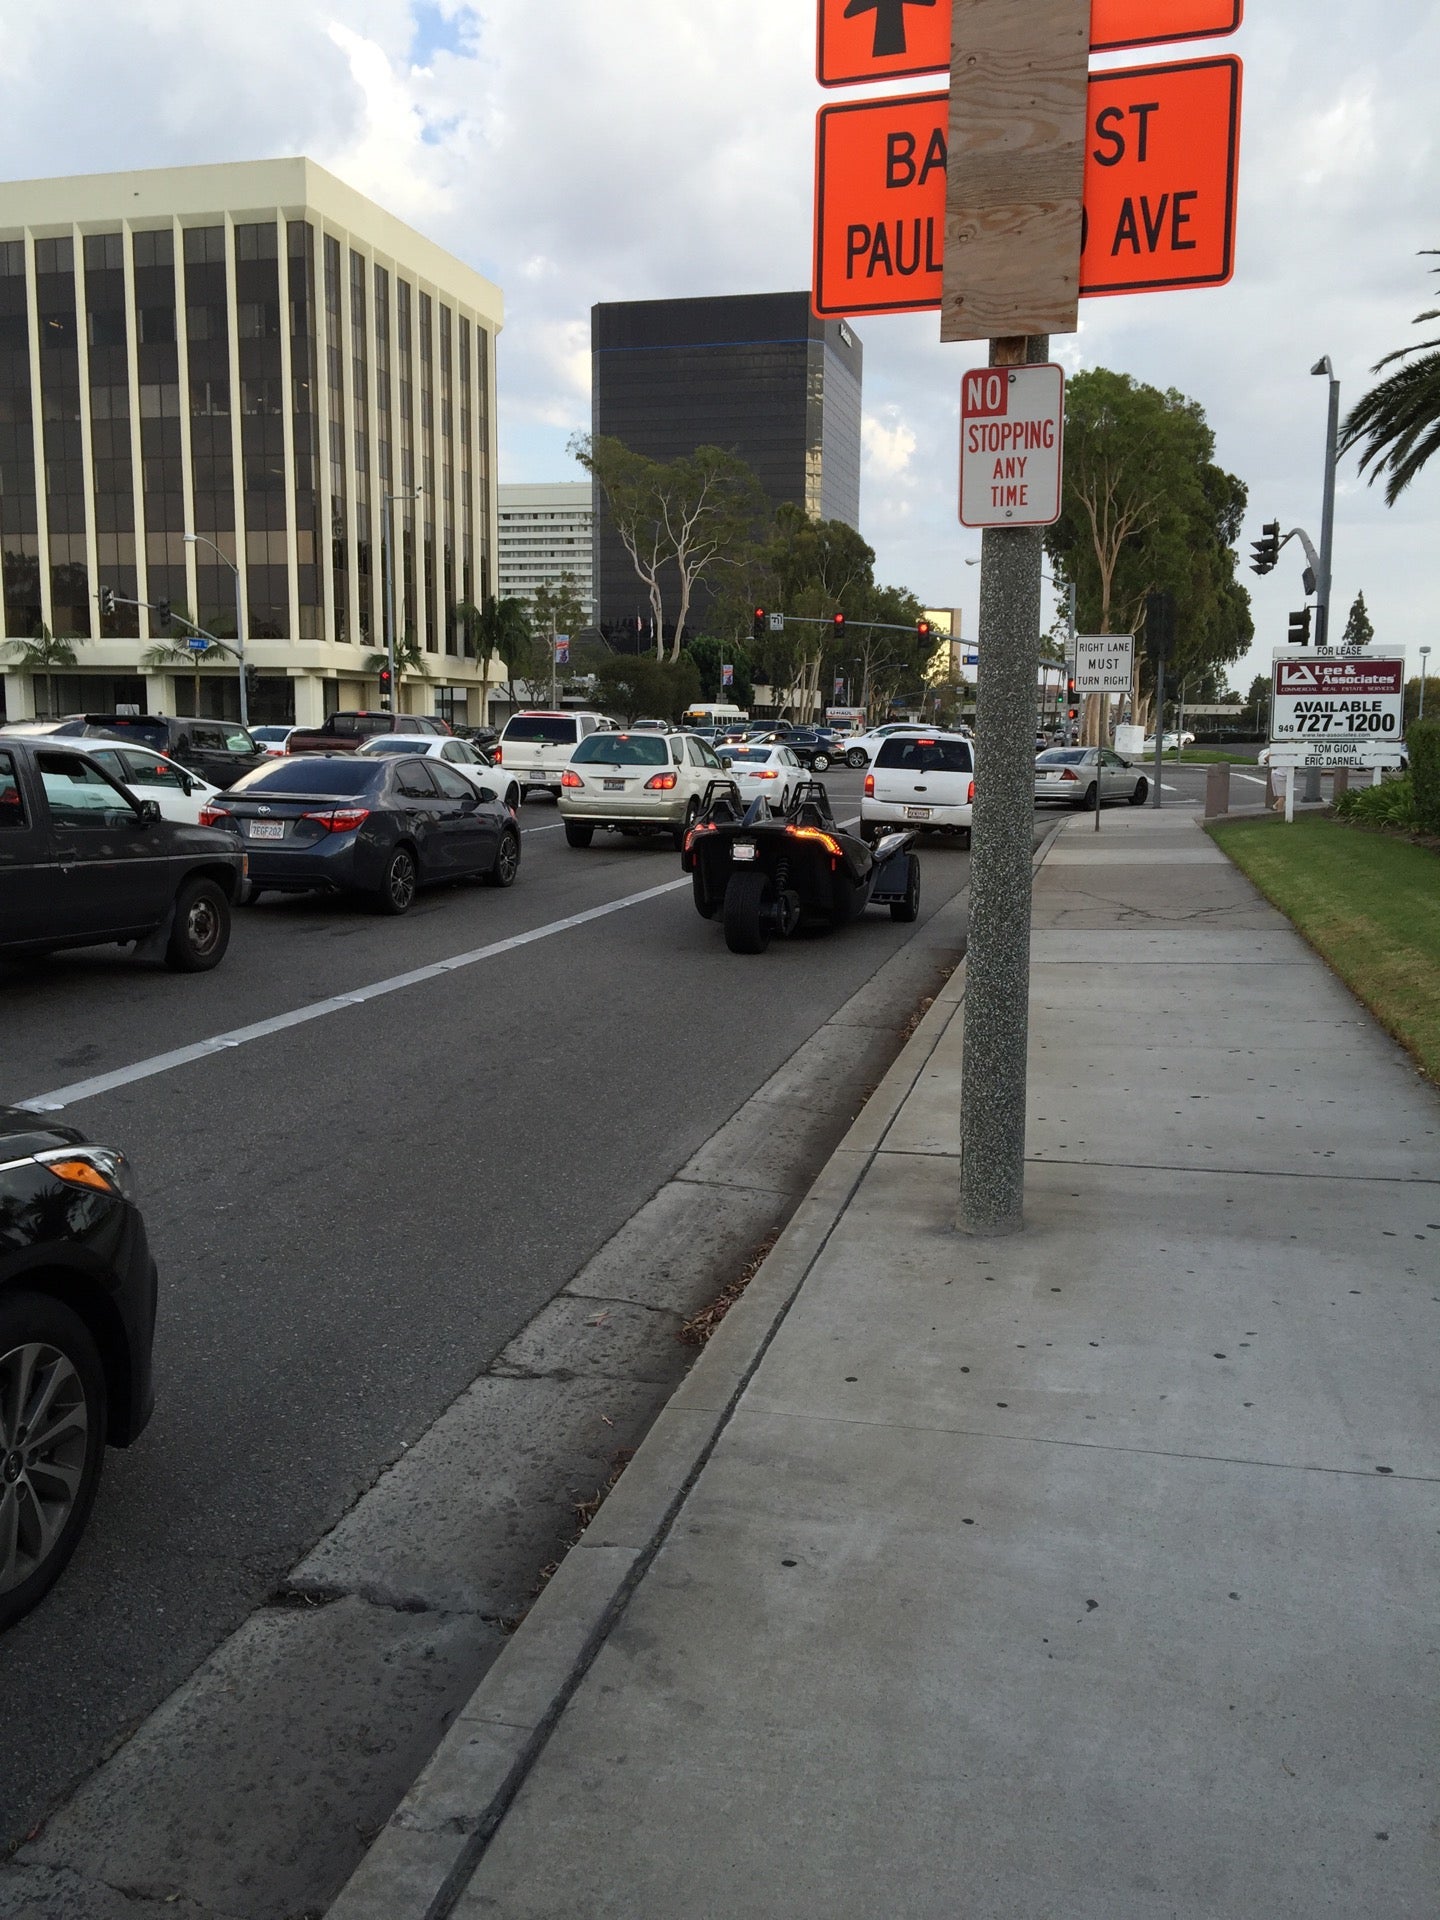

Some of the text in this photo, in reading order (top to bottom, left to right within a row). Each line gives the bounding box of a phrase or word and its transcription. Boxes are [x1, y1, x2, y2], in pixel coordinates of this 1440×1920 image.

[1093, 103, 1159, 167] ST
[1111, 190, 1198, 257] AVE
[967, 375, 1002, 411] NO
[968, 419, 1054, 453] STOPPING
[993, 456, 1028, 480] ANY
[991, 484, 1029, 507] TIME
[1079, 643, 1104, 653] RIGHT
[1107, 642, 1130, 652] LANE
[1316, 646, 1362, 656] FOR LEASE
[1088, 658, 1120, 670] MUST
[1315, 665, 1356, 676] Lee &
[1077, 676, 1129, 686] TURN RIGHT
[1321, 675, 1396, 685] Associates
[1293, 701, 1383, 713] AVAILABLE
[1278, 713, 1395, 733] 949 727-1200
[1313, 744, 1358, 753] TOM GIOIA
[1304, 756, 1364, 766] ERIC DARNELL
